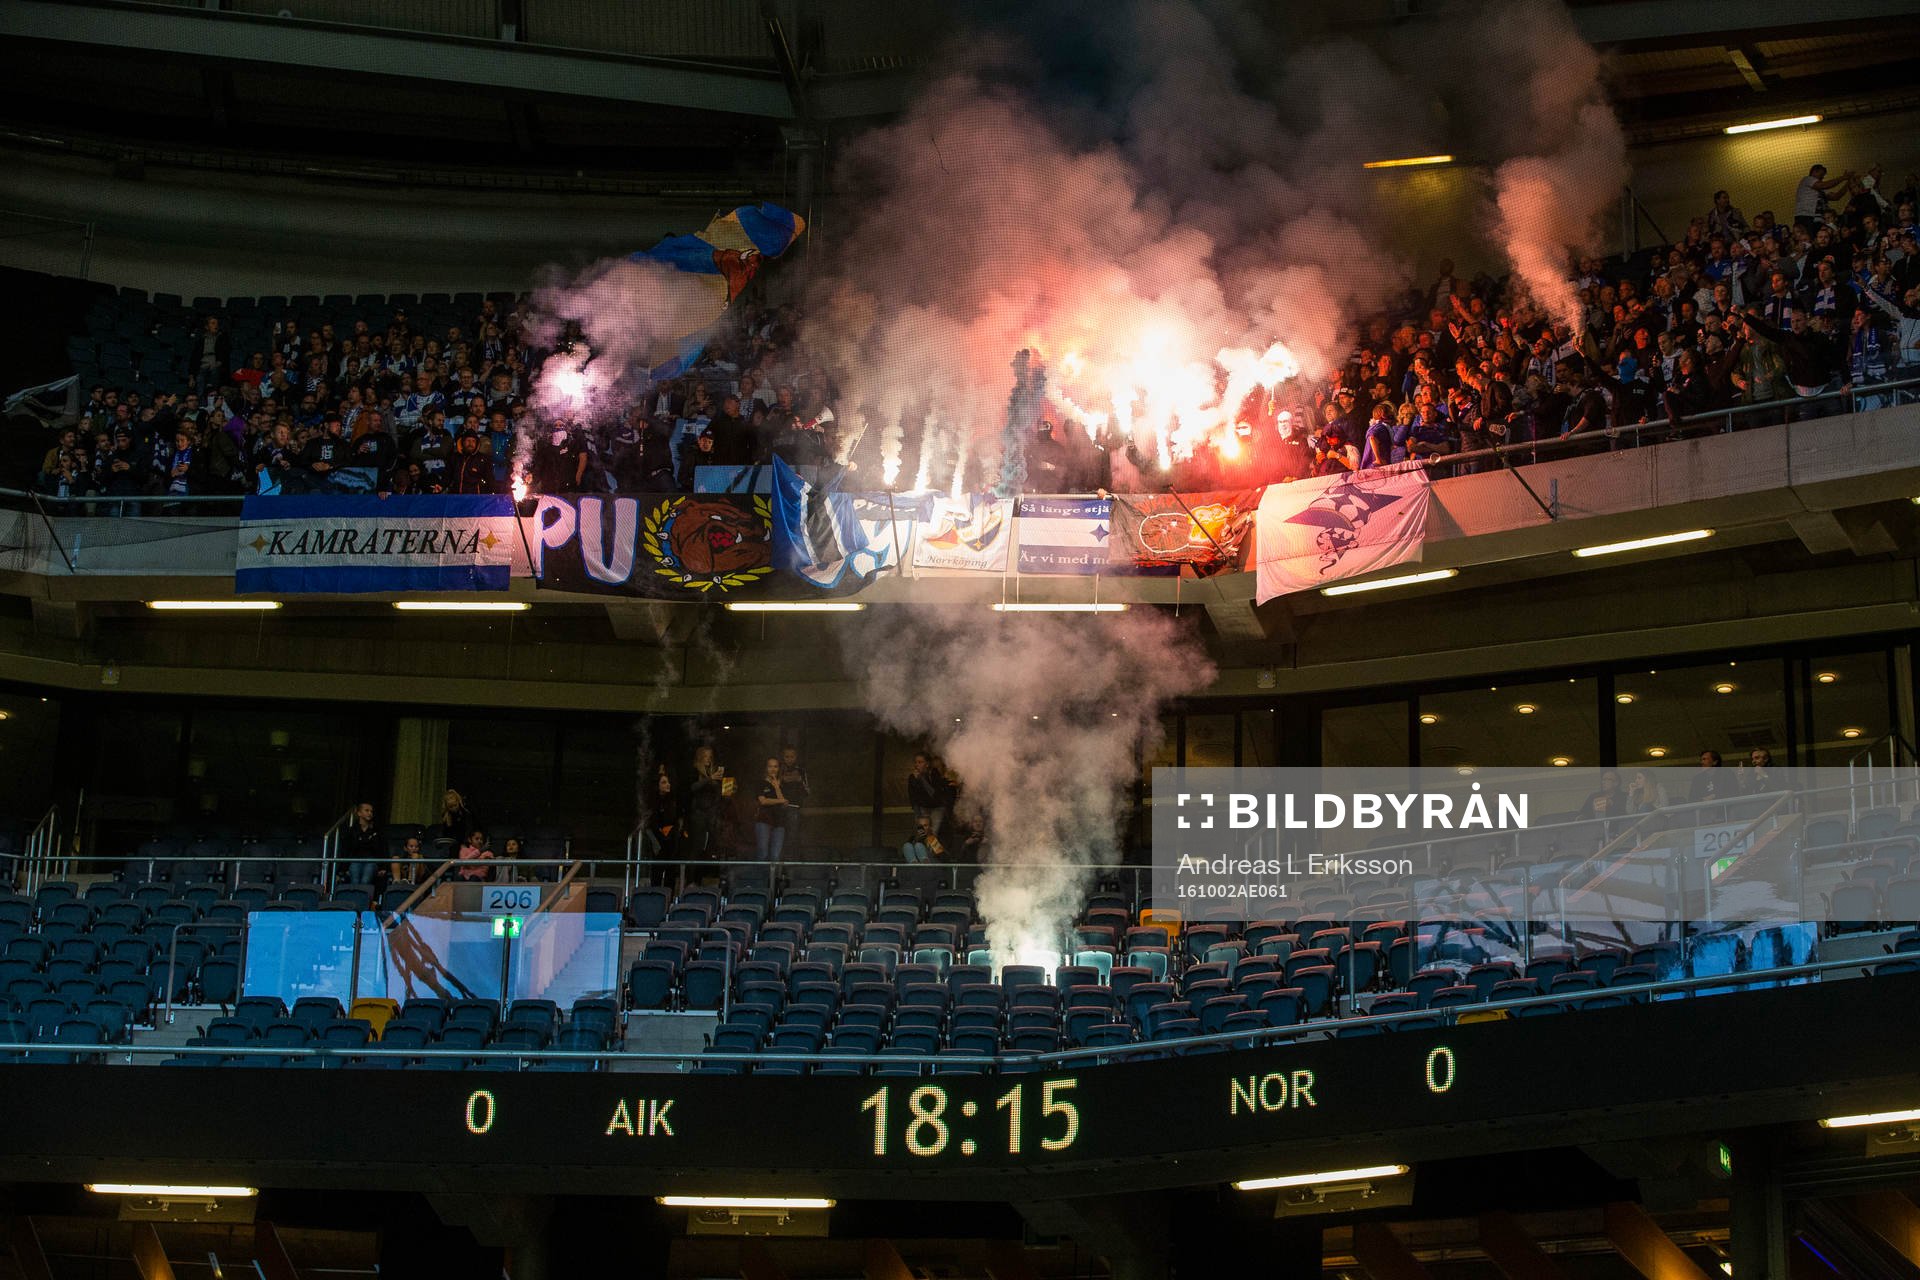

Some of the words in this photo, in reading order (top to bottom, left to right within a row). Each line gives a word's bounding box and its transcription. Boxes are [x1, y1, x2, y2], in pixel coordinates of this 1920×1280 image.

[1020, 503, 1036, 513] Så
[1040, 504, 1081, 516] länge
[266, 528, 480, 555] KAMRATERNA
[1019, 550, 1037, 563] Är
[1041, 553, 1055, 564] vi
[1058, 553, 1089, 565] med
[926, 555, 989, 569] Norrköping
[489, 890, 532, 910] 206
[1426, 1046, 1456, 1093] 0
[1231, 1069, 1318, 1115] NOR
[466, 1090, 496, 1134] 0
[605, 1099, 675, 1136] AIK
[861, 1078, 1079, 1157] 18:15
